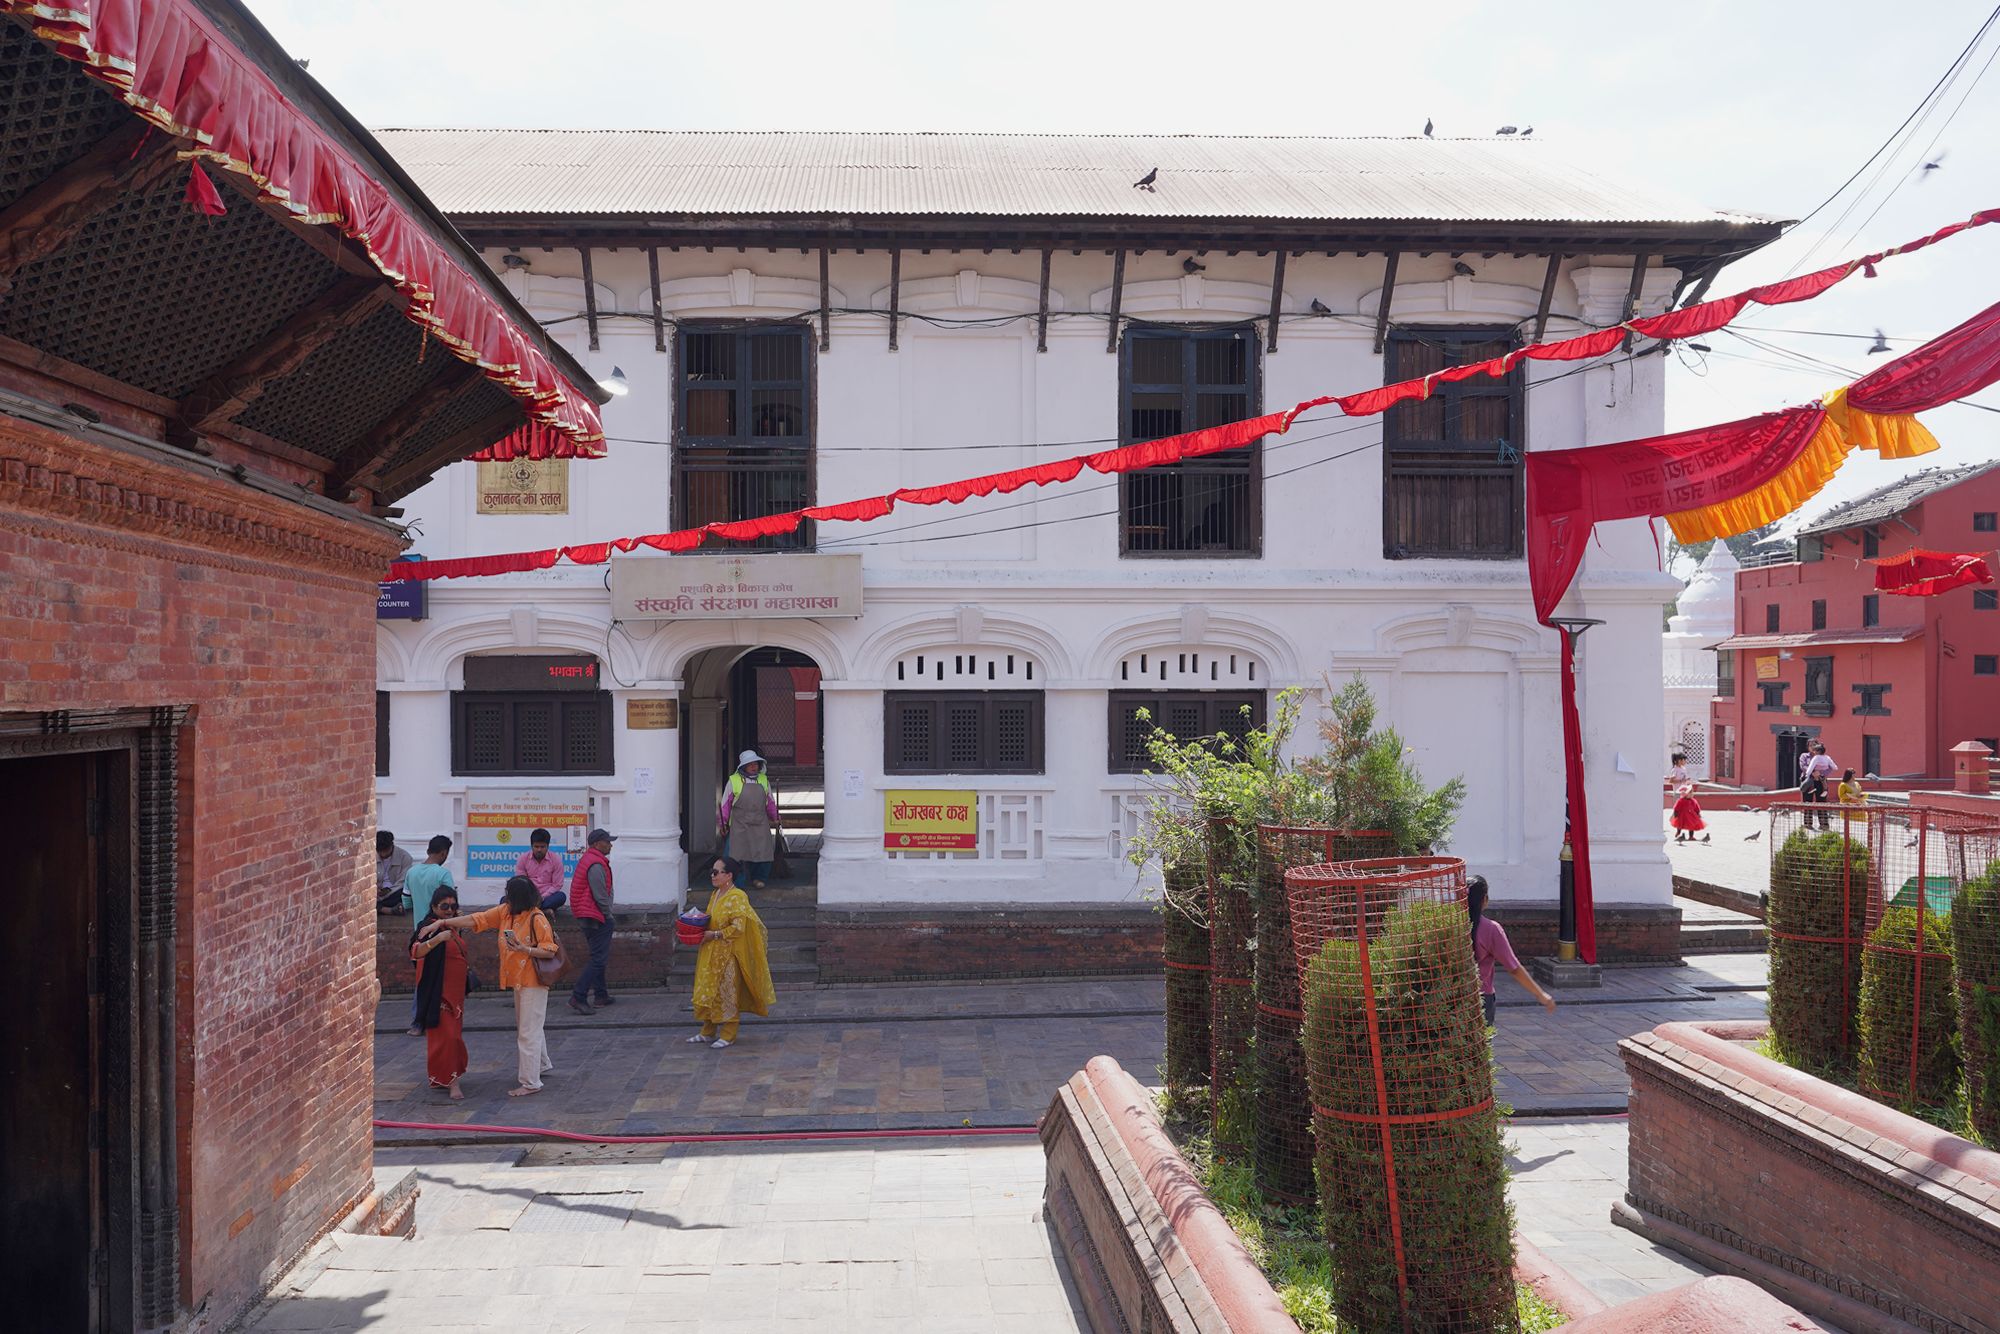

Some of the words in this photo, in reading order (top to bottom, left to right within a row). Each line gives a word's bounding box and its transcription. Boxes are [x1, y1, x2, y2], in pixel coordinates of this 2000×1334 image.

[484, 492, 521, 508] कुलानन्द
[523, 492, 537, 505] झा
[680, 583, 714, 595] पशुपति
[716, 583, 734, 593] क्षेत्र
[738, 582, 769, 593] विकास
[773, 582, 793, 593] कोष
[634, 595, 694, 614] संस्कृति
[700, 595, 759, 611] संरक्षण
[764, 596, 839, 611] महाशाखा
[549, 666, 583, 678] भगवान
[893, 800, 943, 821] खोजखबर
[946, 805, 968, 822] कक्ष
[470, 851, 523, 860] DONATIO
[480, 864, 516, 873] (PURCH
